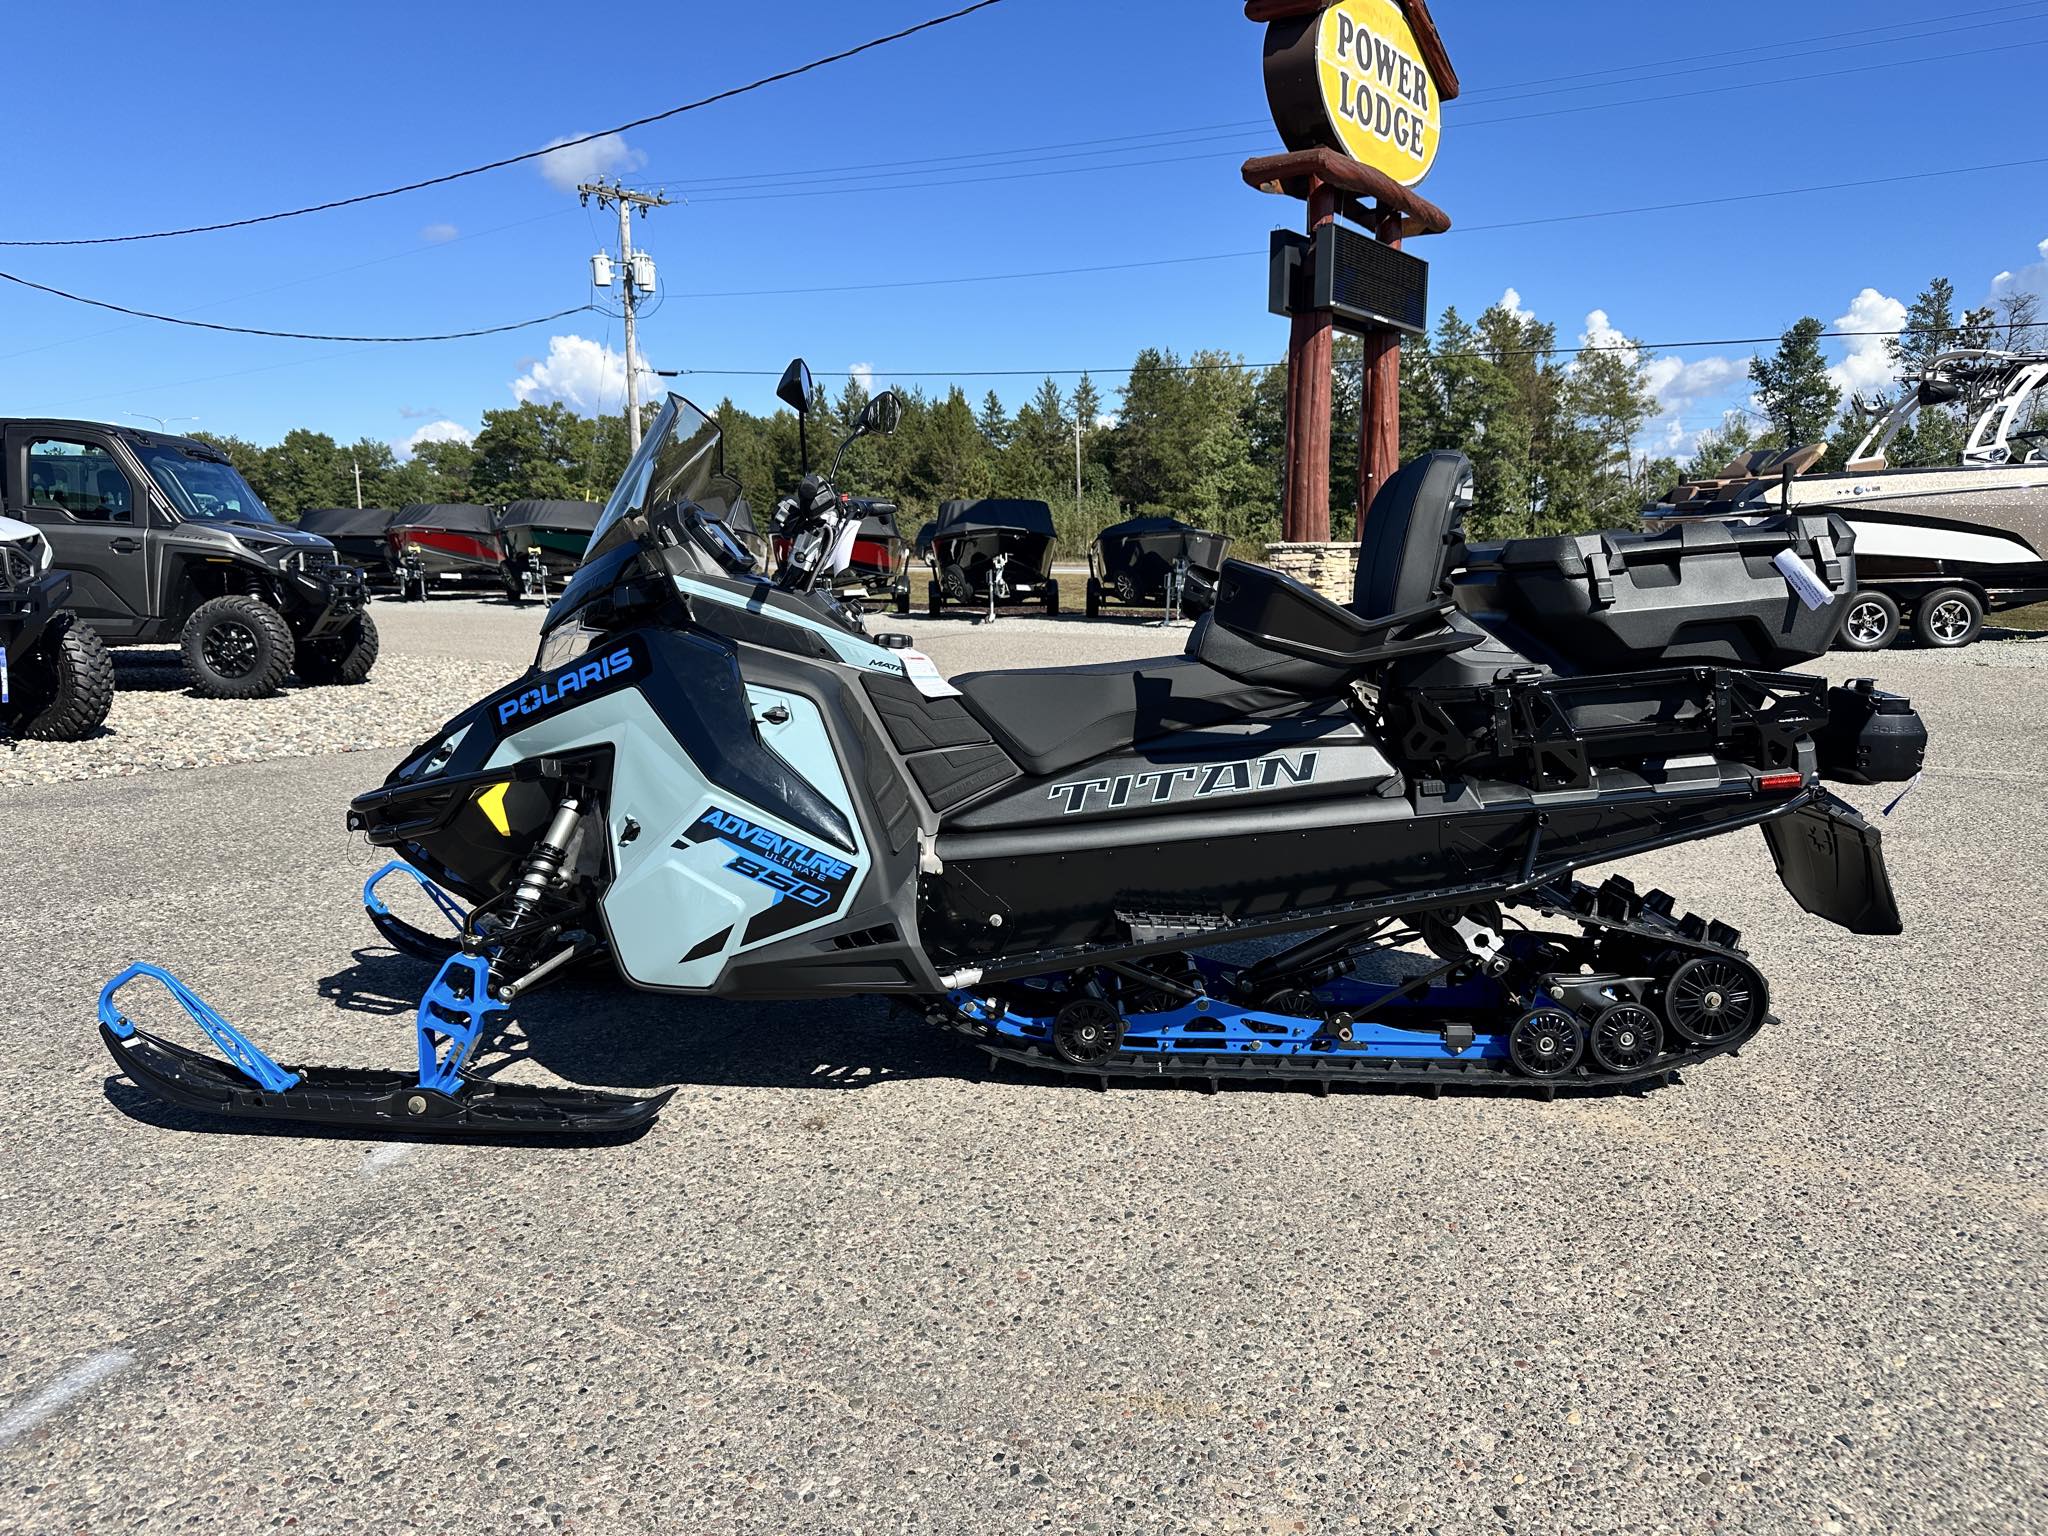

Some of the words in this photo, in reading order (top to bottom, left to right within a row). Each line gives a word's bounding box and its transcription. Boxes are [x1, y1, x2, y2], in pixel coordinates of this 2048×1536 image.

[1337, 12, 1428, 112] POWER
[1339, 71, 1424, 158] LODGE
[498, 647, 633, 725] POLARIS
[868, 659, 907, 673] MATR
[1048, 750, 1320, 815] TITAN
[700, 810, 852, 881] ADVENTURE
[764, 851, 827, 882] ULTIMATE
[722, 855, 831, 908] 850
